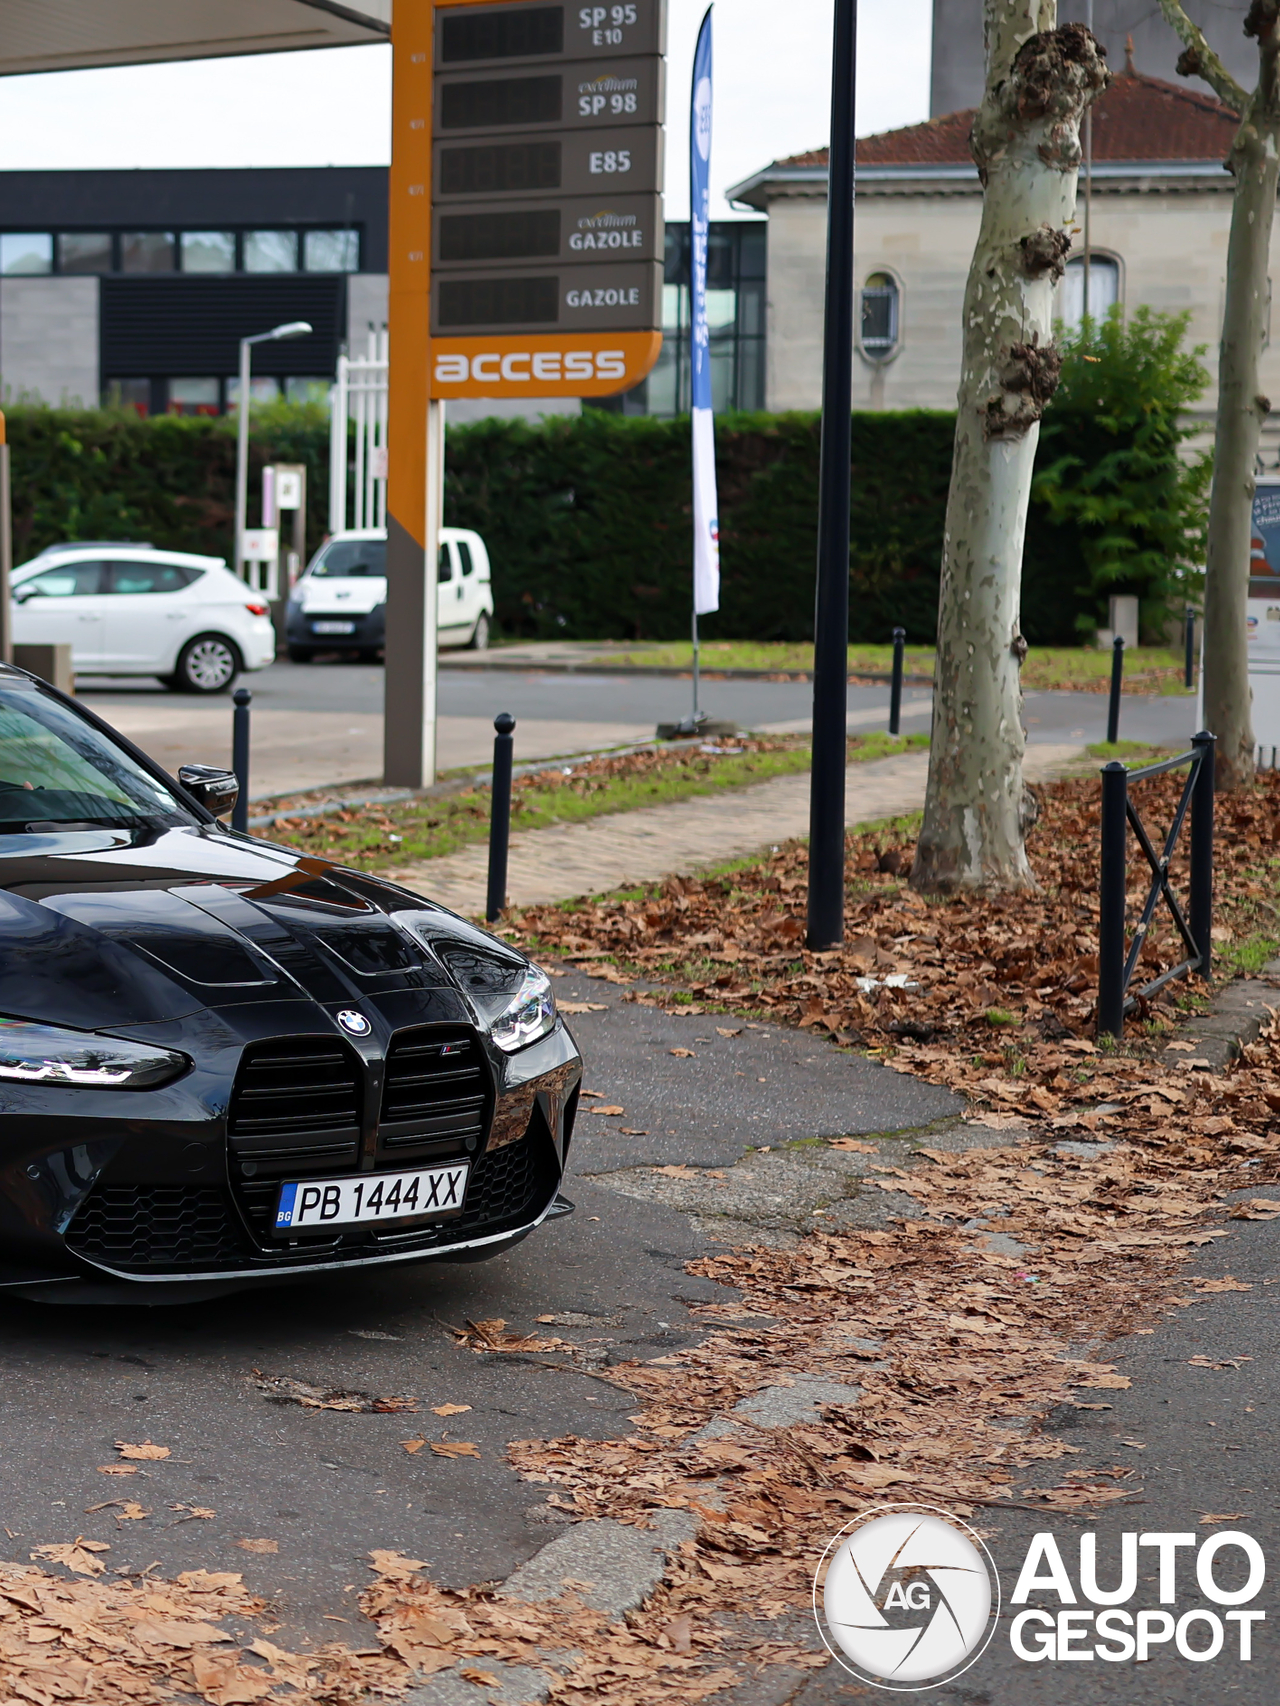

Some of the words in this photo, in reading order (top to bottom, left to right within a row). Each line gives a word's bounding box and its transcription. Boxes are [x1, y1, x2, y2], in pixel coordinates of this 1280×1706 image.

[579, 6, 607, 29] SP
[611, 4, 637, 26] 95
[593, 28, 623, 46] E10
[578, 95, 607, 117] SP
[610, 92, 638, 115] 98
[589, 150, 631, 174] E85
[569, 229, 643, 250] GAZOLE
[565, 287, 639, 308] GAZOLE
[298, 1185, 341, 1222] PB
[353, 1176, 420, 1217] 1444
[424, 1170, 463, 1209] XX
[276, 1211, 292, 1222] BG
